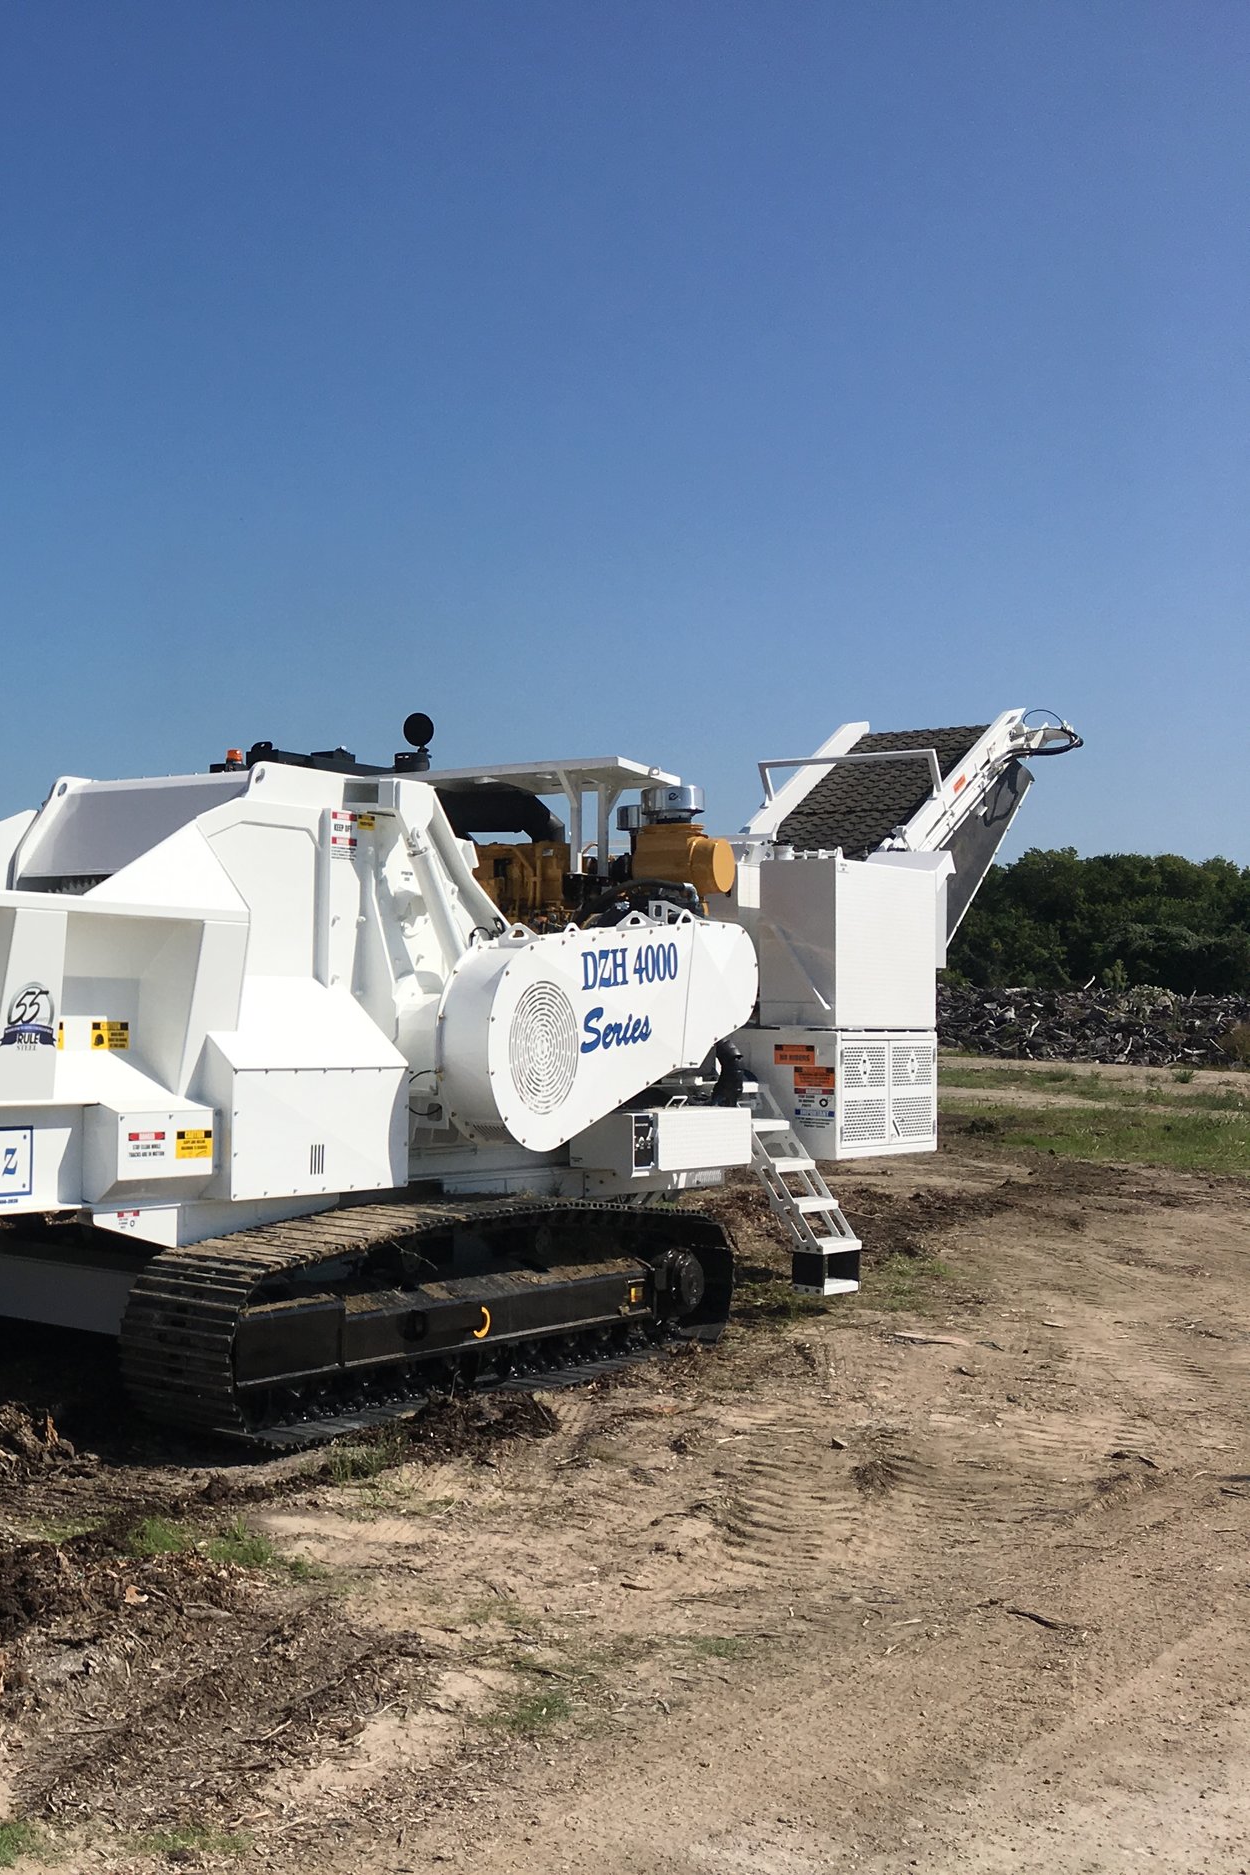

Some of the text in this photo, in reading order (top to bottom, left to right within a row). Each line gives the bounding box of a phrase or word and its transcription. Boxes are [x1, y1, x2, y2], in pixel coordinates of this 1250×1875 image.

[581, 942, 678, 990] DZH 4000
[7, 990, 50, 1025] 55
[17, 1033, 39, 1045] RULE
[580, 1007, 652, 1054] Series
[2, 1148, 18, 1176] Z
